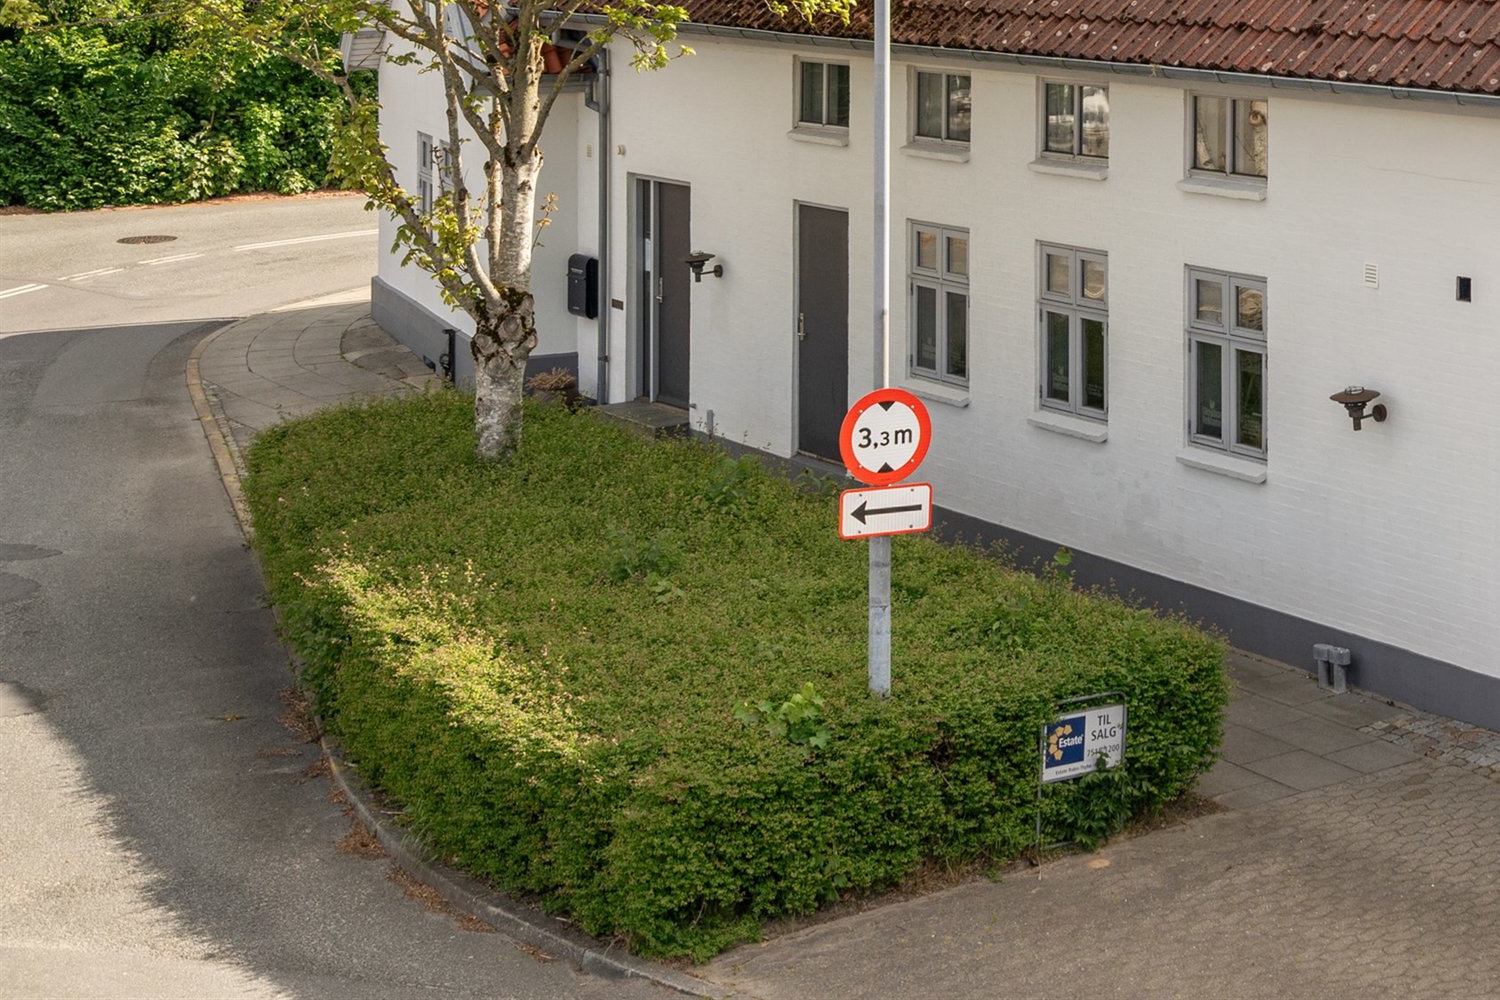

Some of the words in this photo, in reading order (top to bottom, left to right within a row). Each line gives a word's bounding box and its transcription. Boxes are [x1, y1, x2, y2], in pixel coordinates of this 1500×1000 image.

[858, 427, 890, 449] 3,3
[894, 428, 912, 445] m
[1097, 714, 1111, 726] TIL
[1091, 726, 1117, 741] SALG
[1059, 735, 1083, 748] Estate
